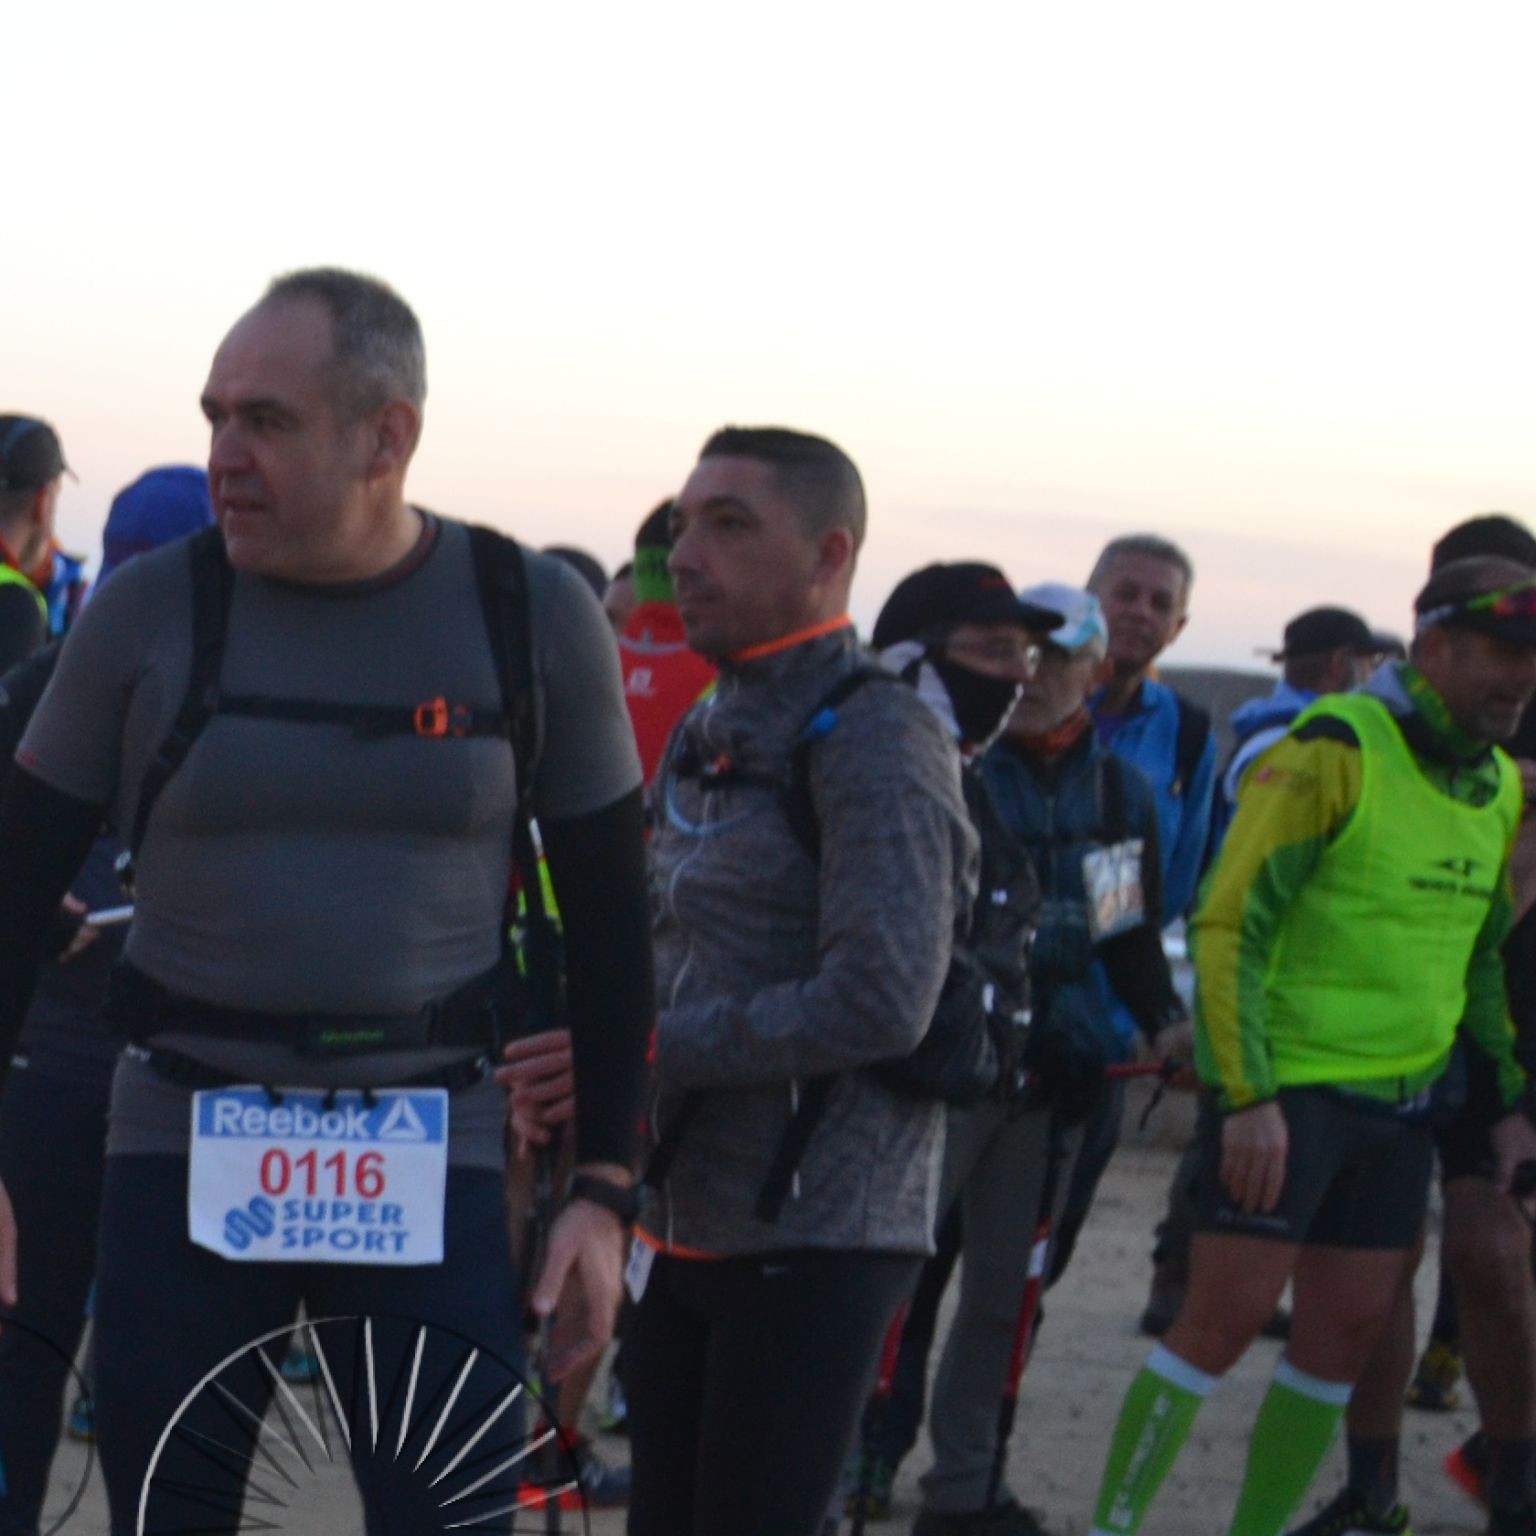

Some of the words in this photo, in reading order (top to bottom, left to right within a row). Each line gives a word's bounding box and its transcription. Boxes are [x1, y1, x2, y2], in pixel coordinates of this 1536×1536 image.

[213, 1098, 371, 1139] Reebok
[259, 1147, 386, 1199] 0116
[282, 1199, 404, 1226] SUPER
[282, 1227, 411, 1254] SPORT
